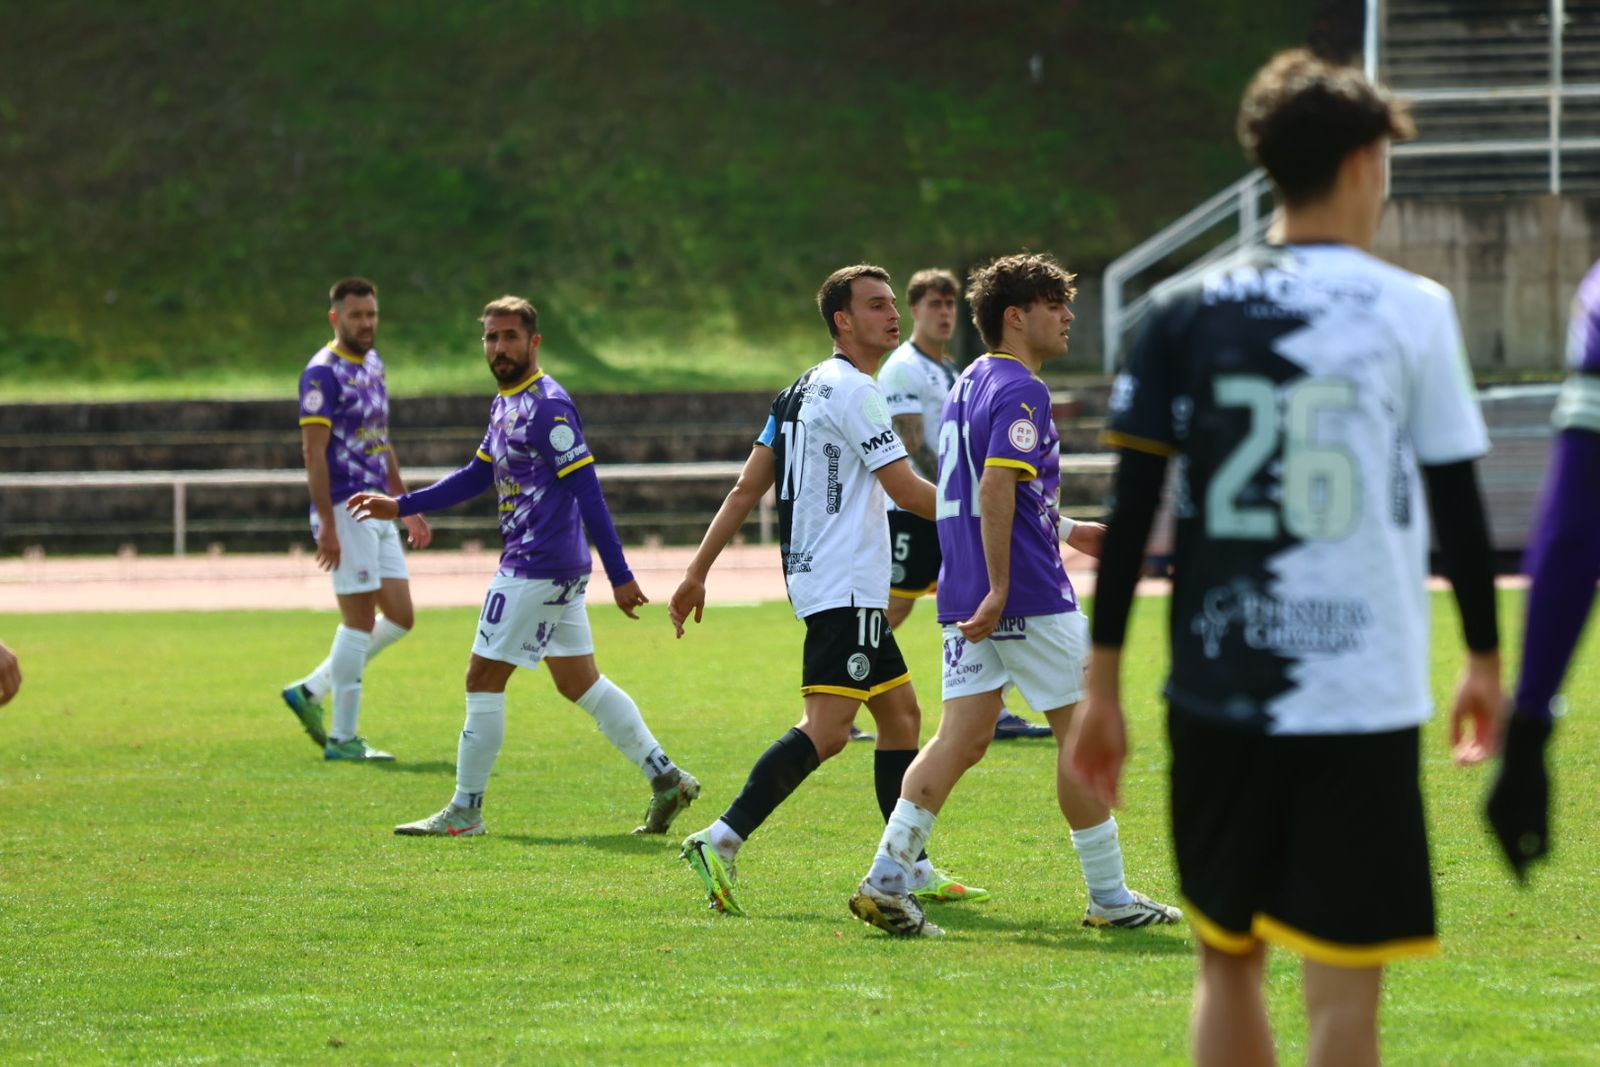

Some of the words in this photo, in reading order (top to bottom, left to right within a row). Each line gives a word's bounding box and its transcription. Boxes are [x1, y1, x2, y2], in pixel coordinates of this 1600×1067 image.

[861, 430, 894, 455] MMG
[1206, 375, 1360, 541] 26
[823, 443, 841, 515] GUINALDO
[935, 420, 981, 521] 21
[893, 533, 911, 561] 5
[481, 591, 506, 625] 10
[856, 608, 882, 648] 10
